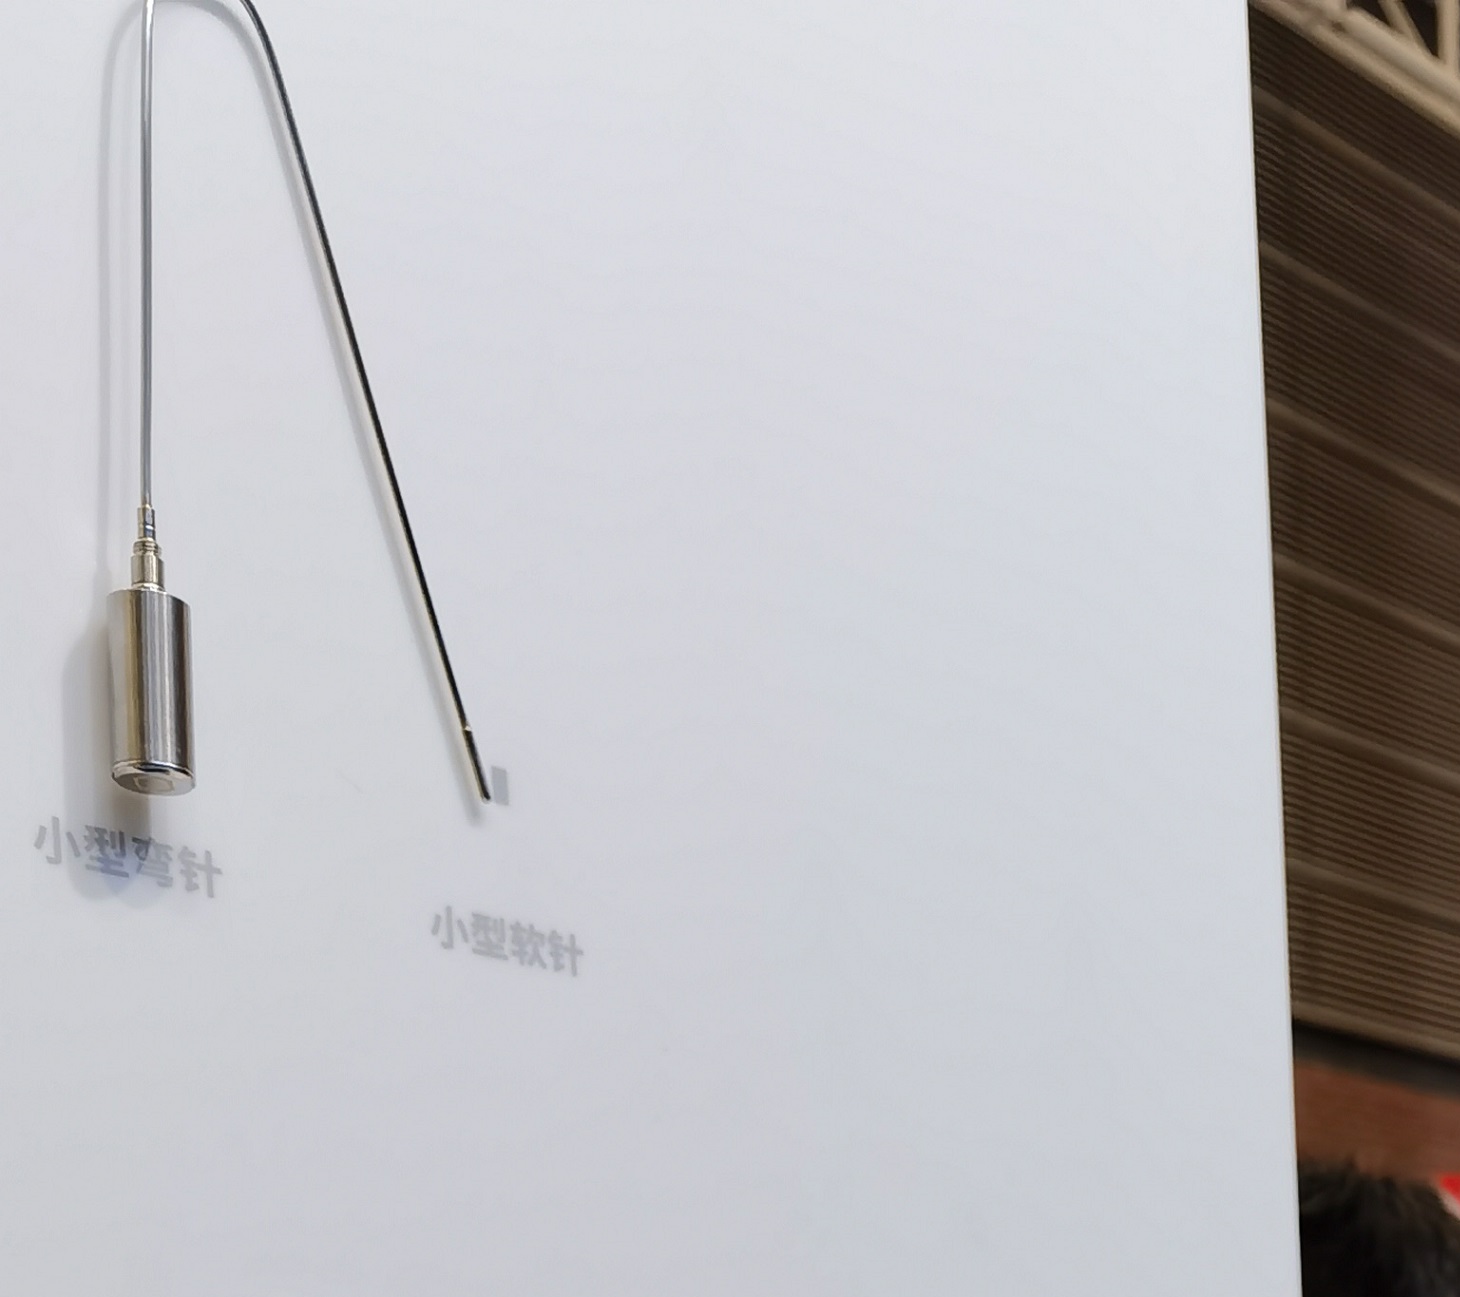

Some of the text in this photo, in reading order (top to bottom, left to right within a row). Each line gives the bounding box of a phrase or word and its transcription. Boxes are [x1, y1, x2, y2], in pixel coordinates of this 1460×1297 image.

[33, 815, 223, 898] 小型弯针
[430, 905, 584, 977] 小型软针
